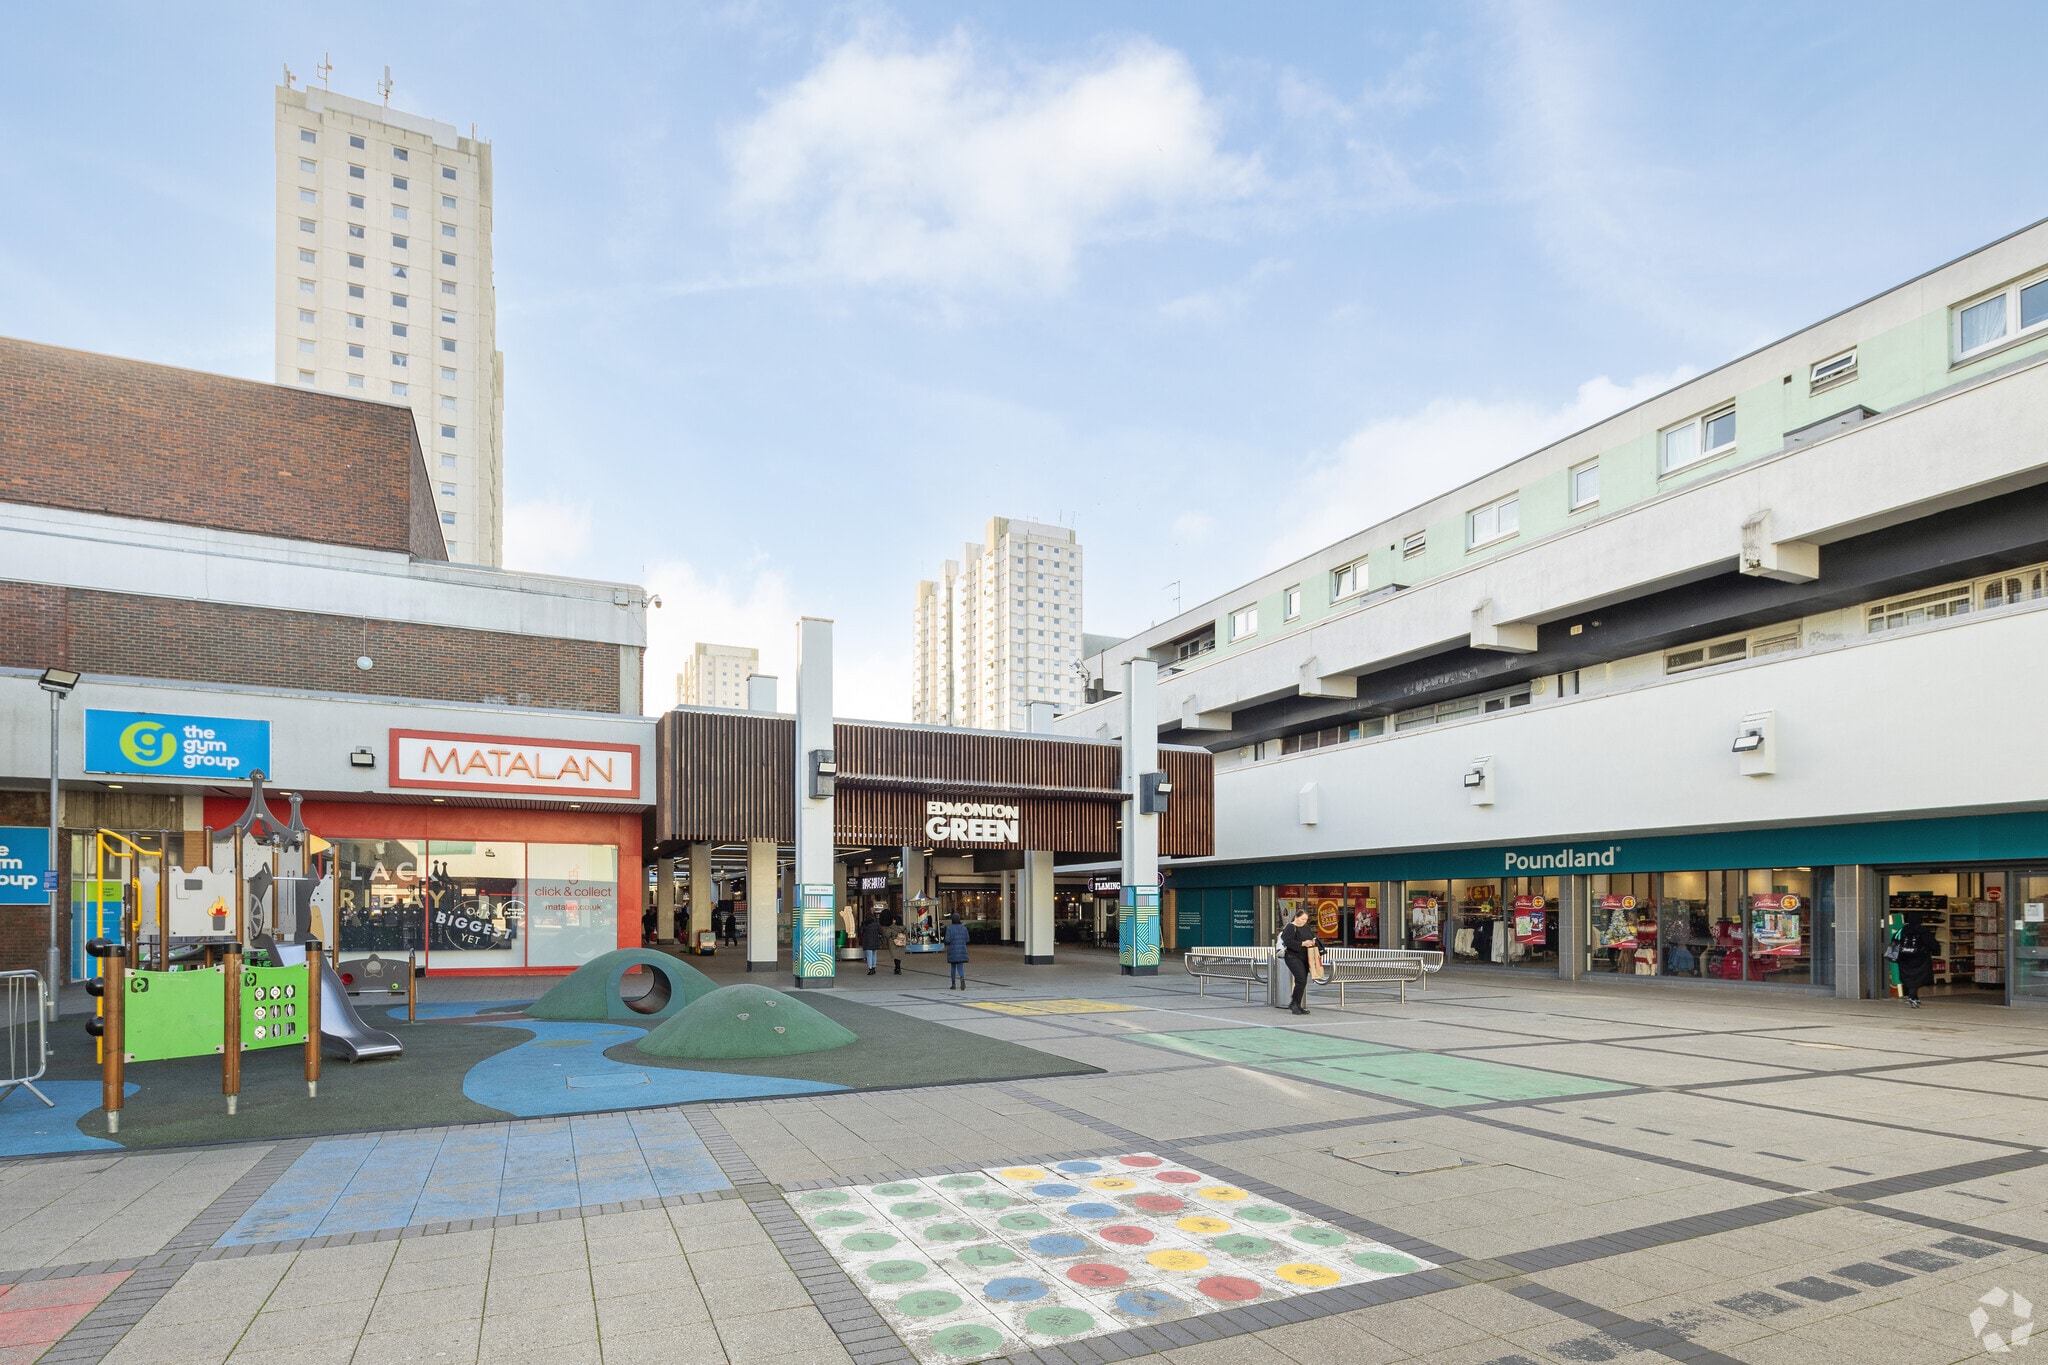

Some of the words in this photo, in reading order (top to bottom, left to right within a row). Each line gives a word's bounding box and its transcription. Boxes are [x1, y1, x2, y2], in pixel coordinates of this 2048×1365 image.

[183, 725, 215, 739] the
[183, 739, 227, 754] gym
[183, 755, 240, 770] group
[422, 746, 613, 782] MATALAN
[926, 801, 1019, 819] EDMONTON
[925, 816, 1019, 843] GREEN
[0, 874, 38, 890] oup
[339, 888, 446, 908] RIDAY
[534, 886, 561, 897] click
[564, 886, 572, 897] &
[574, 886, 612, 897] collect
[1474, 886, 1489, 899] £1
[545, 903, 602, 912] matalan.co.uk
[1783, 898, 1796, 907] £1
[466, 907, 490, 919] OUR
[1322, 916, 1338, 924] SALE
[435, 911, 512, 940] BIGGEST
[461, 933, 480, 945] YET
